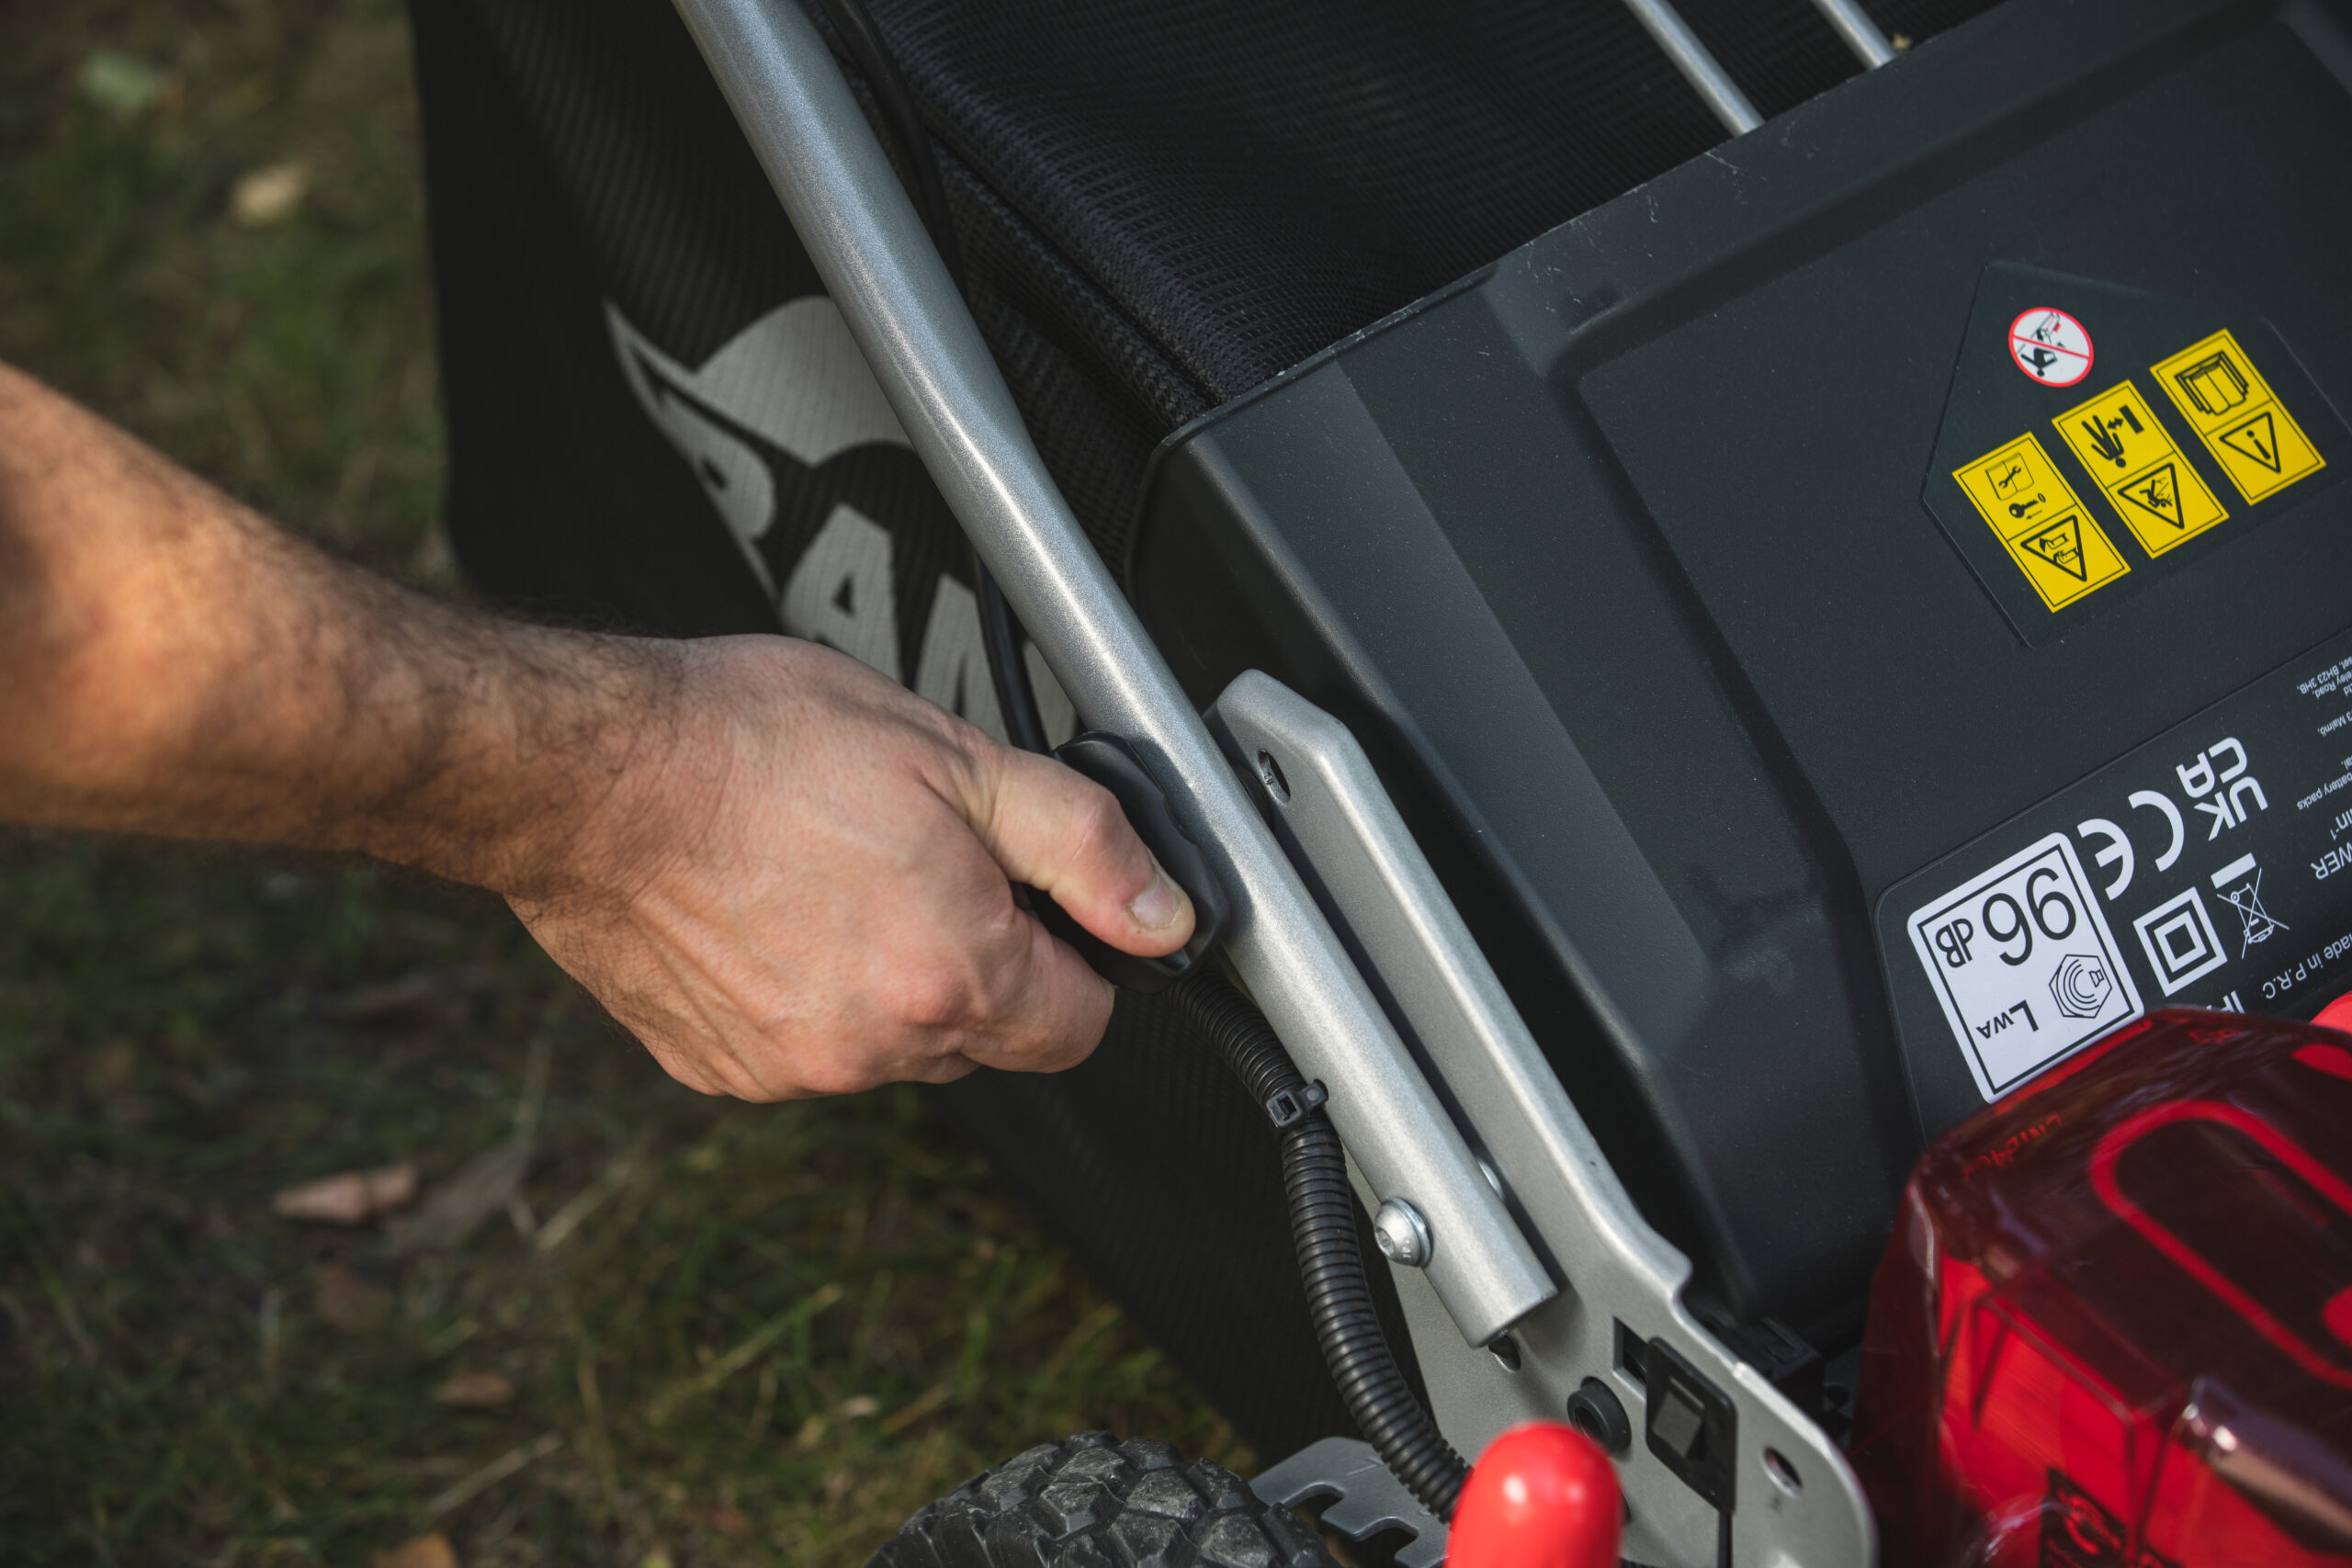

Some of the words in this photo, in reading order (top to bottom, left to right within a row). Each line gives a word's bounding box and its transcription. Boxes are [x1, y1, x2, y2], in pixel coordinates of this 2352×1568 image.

[2317, 665, 2339, 684] BH23
[2176, 737, 2248, 798] CA
[2193, 776, 2269, 842] UK
[2297, 787, 2324, 810] packs
[1982, 867, 2077, 966] 96
[1934, 918, 1974, 969] dB
[2307, 953, 2324, 970] in
[2324, 933, 2352, 960] ade
[2262, 963, 2307, 999] P.R.C
